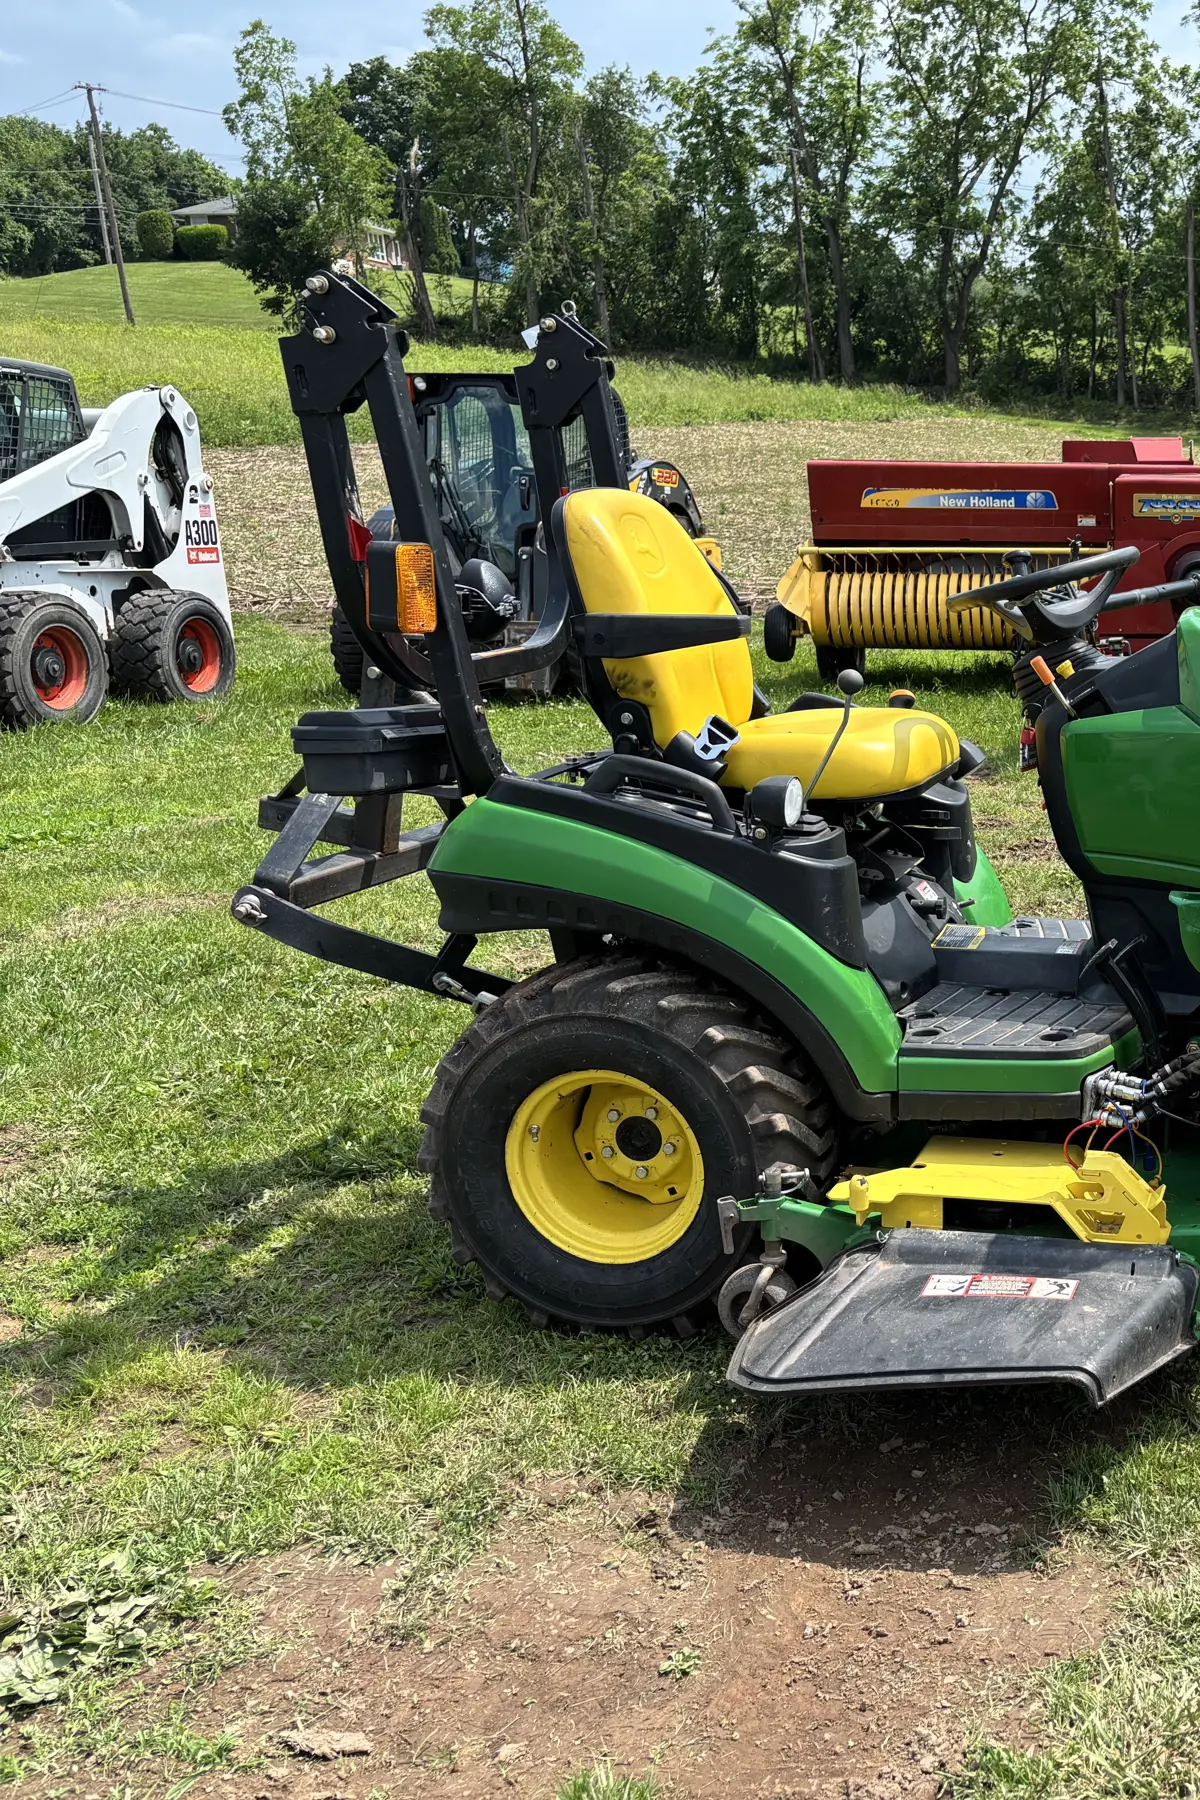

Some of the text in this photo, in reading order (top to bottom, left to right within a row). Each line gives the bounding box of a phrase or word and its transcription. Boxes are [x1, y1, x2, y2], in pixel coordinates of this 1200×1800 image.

[939, 496, 1015, 508] New Holland
[185, 519, 218, 546] A300
[197, 551, 218, 562] Bobcat
